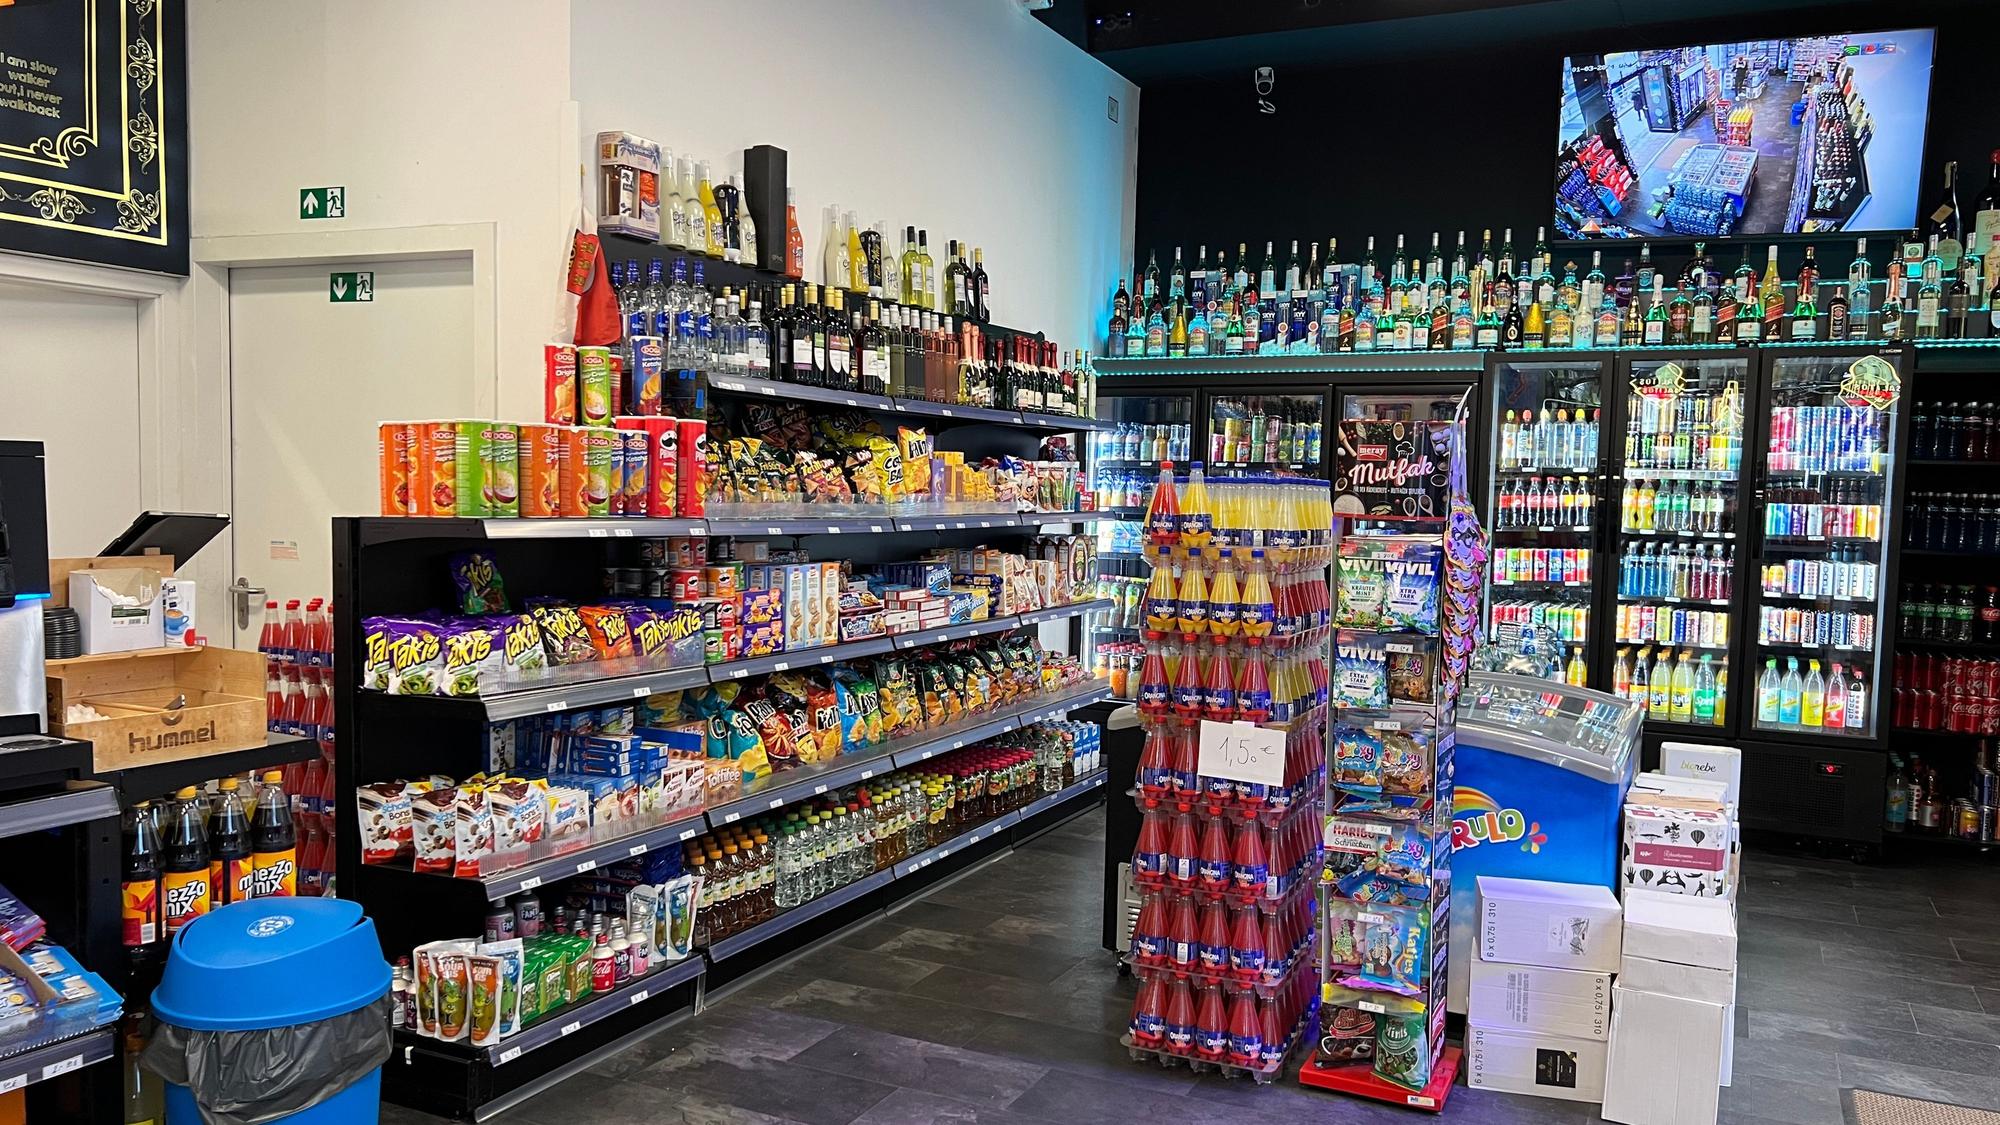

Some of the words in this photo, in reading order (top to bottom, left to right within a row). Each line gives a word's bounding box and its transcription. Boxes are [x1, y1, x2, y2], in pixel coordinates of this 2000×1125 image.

[6, 56, 28, 69] am
[30, 60, 58, 76] slow
[8, 70, 50, 88] walker
[26, 89, 62, 104] never
[492, 432, 514, 440] DOGA
[628, 440, 648, 448] DOGA
[1360, 448, 1385, 456] meray
[1348, 455, 1436, 486] Mutfak
[1384, 561, 1435, 576] VIVIL
[1351, 584, 1376, 592] KRÄUTER
[543, 607, 582, 644] Takis
[598, 613, 626, 646] Takis
[389, 632, 440, 677] Takis
[1144, 692, 1166, 700] ORANGINA
[128, 720, 216, 753] hummel
[706, 767, 741, 788] Toffifee
[166, 880, 206, 902] ezzo
[1488, 902, 1496, 918] 310
[1488, 925, 1496, 943] 0,75
[1404, 926, 1420, 976] Katjes
[1594, 992, 1603, 1010] 0,75
[1594, 1018, 1602, 1034] 310
[1170, 1032, 1190, 1040] ORANGINA
[1476, 1030, 1484, 1046] 310
[1475, 1053, 1484, 1071] 0,75
